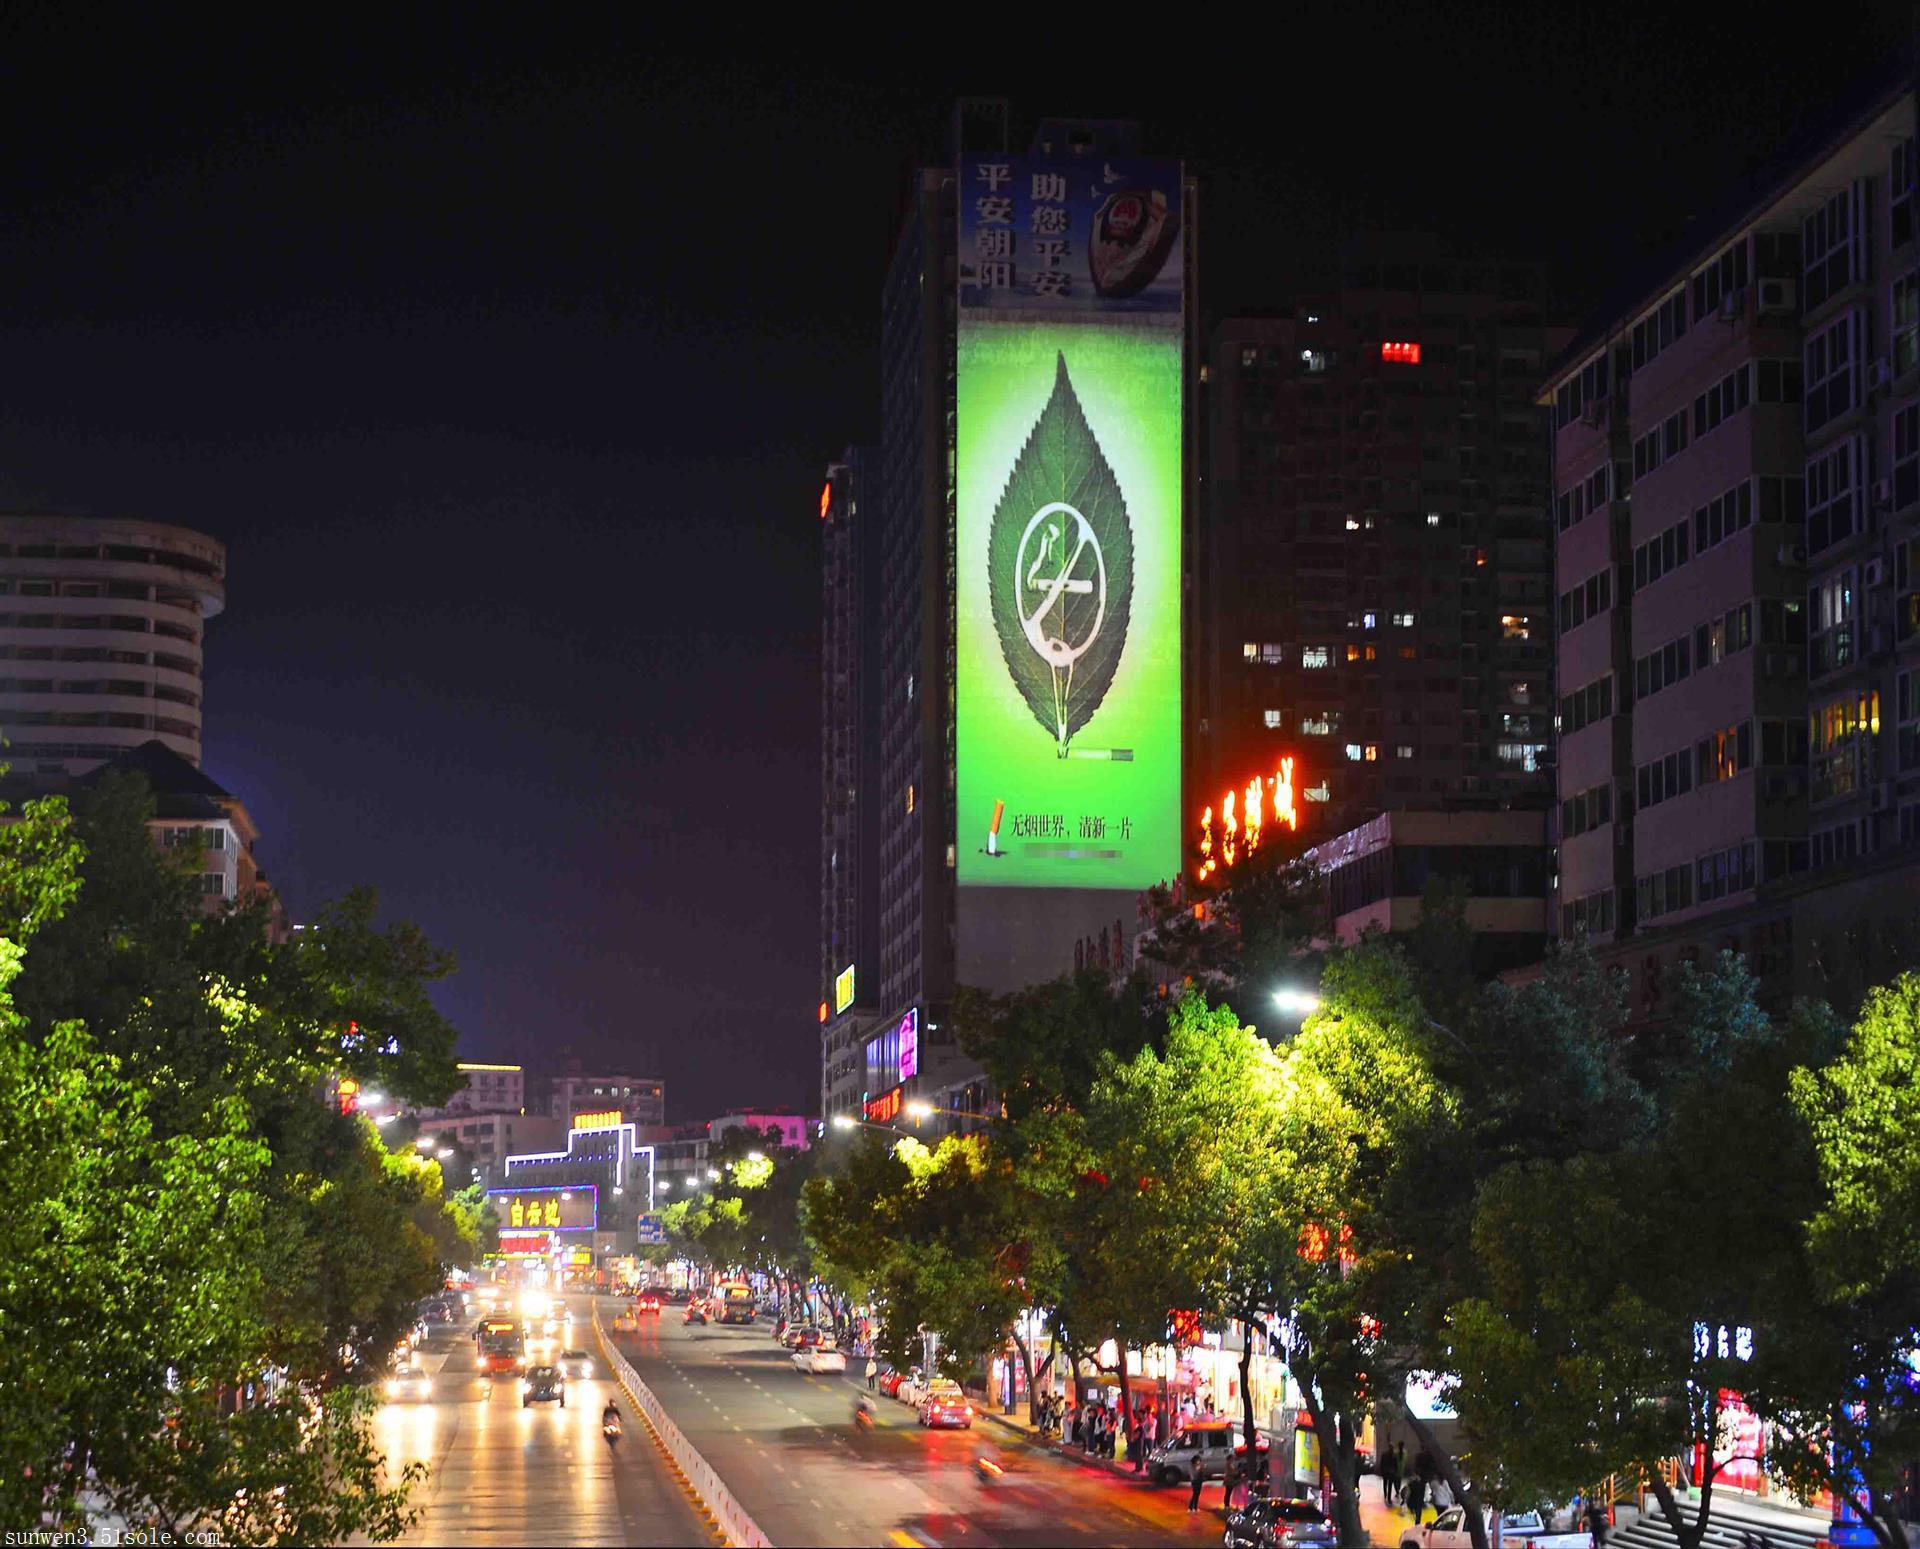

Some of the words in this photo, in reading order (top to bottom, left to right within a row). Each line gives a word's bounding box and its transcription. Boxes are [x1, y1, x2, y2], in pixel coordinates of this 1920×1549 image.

[976, 163, 1014, 290] 平安朝阳
[1031, 172, 1070, 298] 助您平安
[1011, 815, 1132, 840] 无烟世界，清新一片
